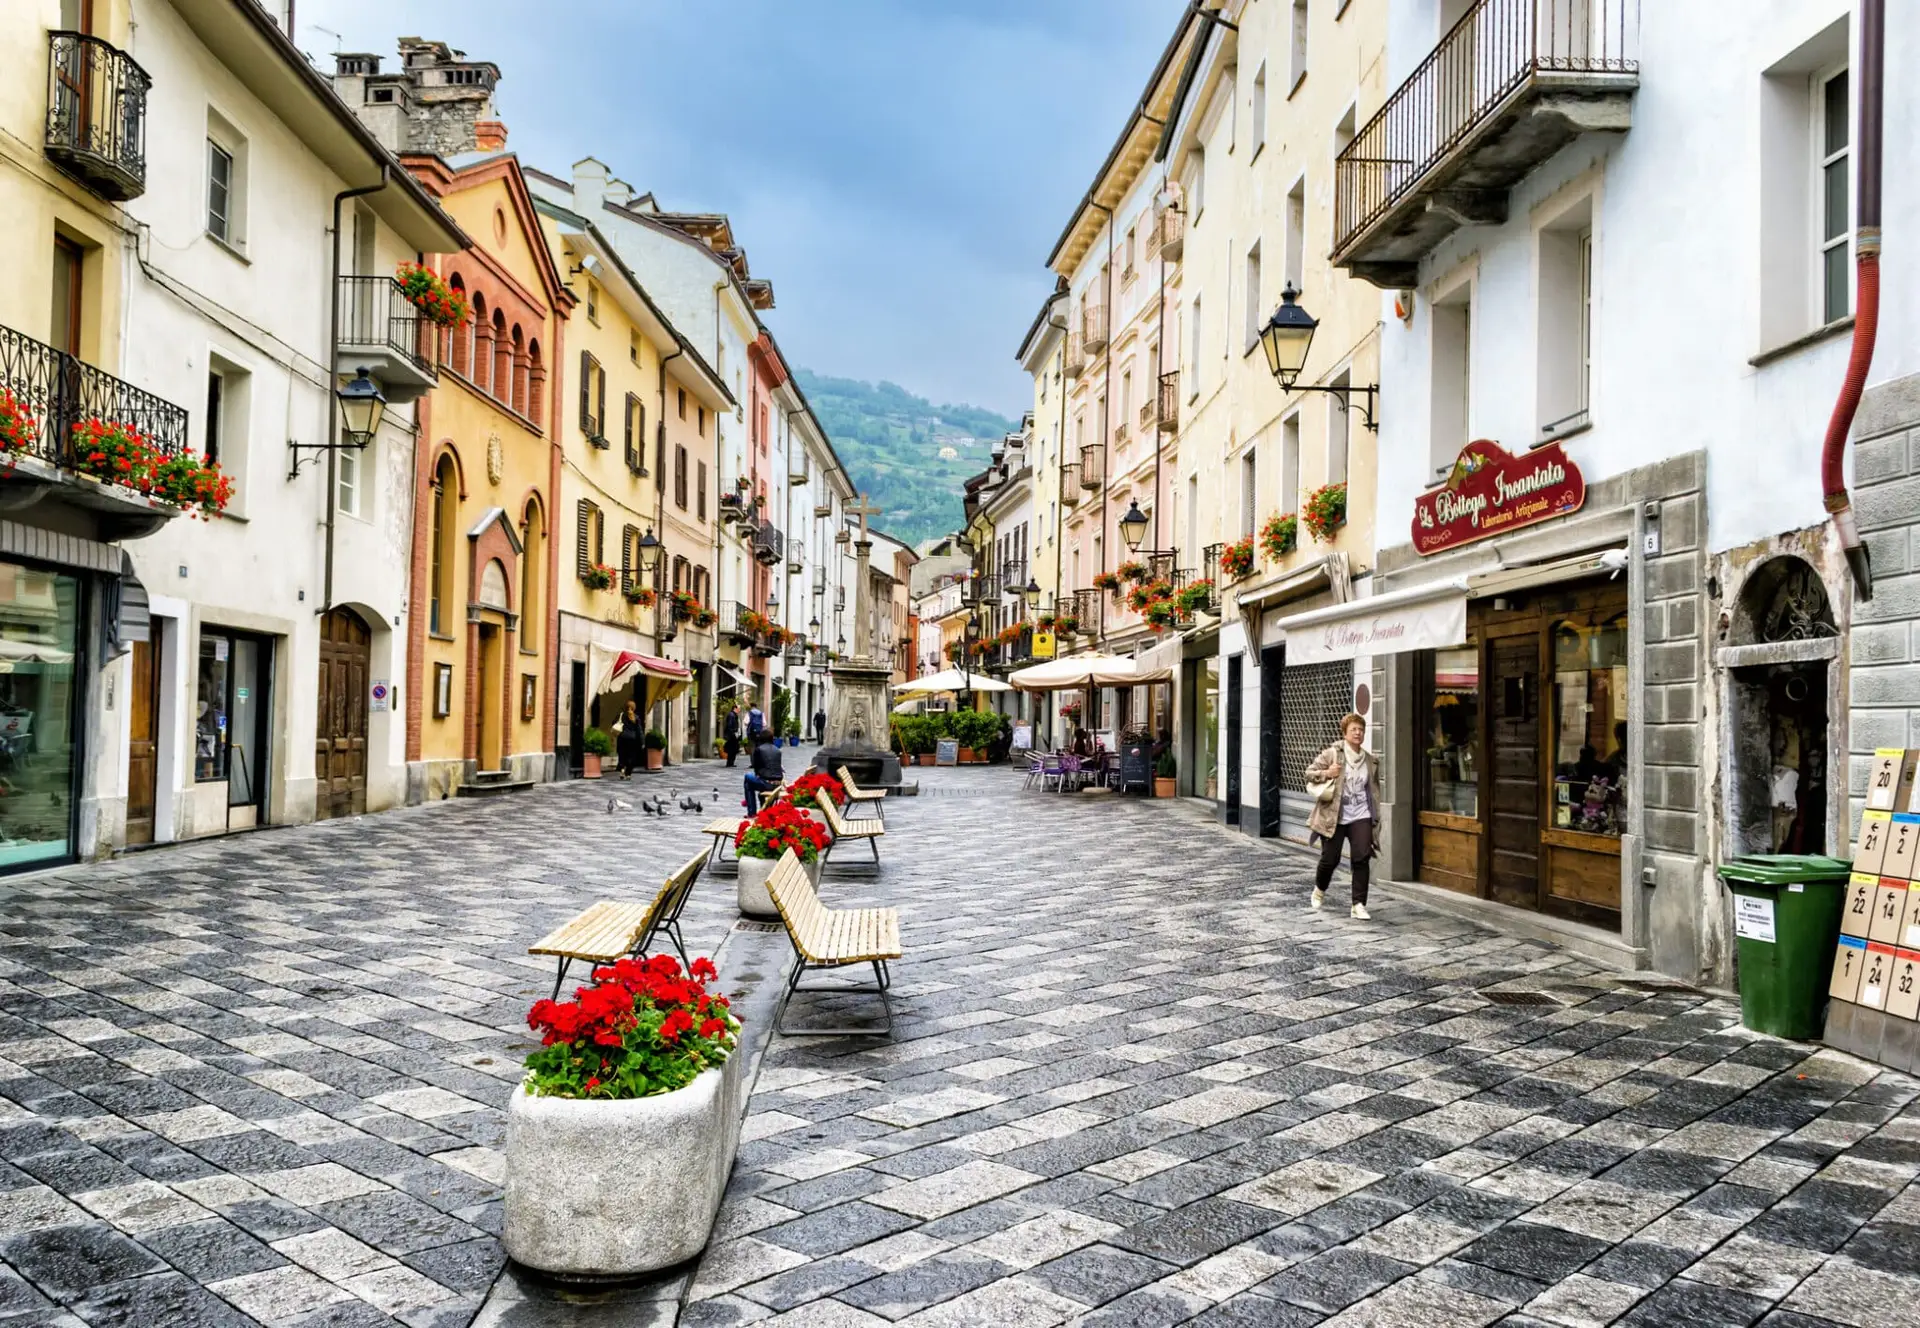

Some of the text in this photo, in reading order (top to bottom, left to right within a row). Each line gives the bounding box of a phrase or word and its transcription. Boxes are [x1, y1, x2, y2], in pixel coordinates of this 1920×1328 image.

[1419, 461, 1565, 528] La Bottega Incantata
[1481, 497, 1549, 528] Laboratorio Artigianale
[1647, 537, 1654, 549] 6
[1877, 772, 1891, 788] 20
[1865, 834, 1878, 851] 21
[1897, 838, 1905, 854] 2
[1852, 898, 1866, 915] 22
[1882, 903, 1894, 920] 14
[1844, 962, 1850, 978] 1
[1868, 967, 1882, 986] 24
[1898, 975, 1913, 994] 32
